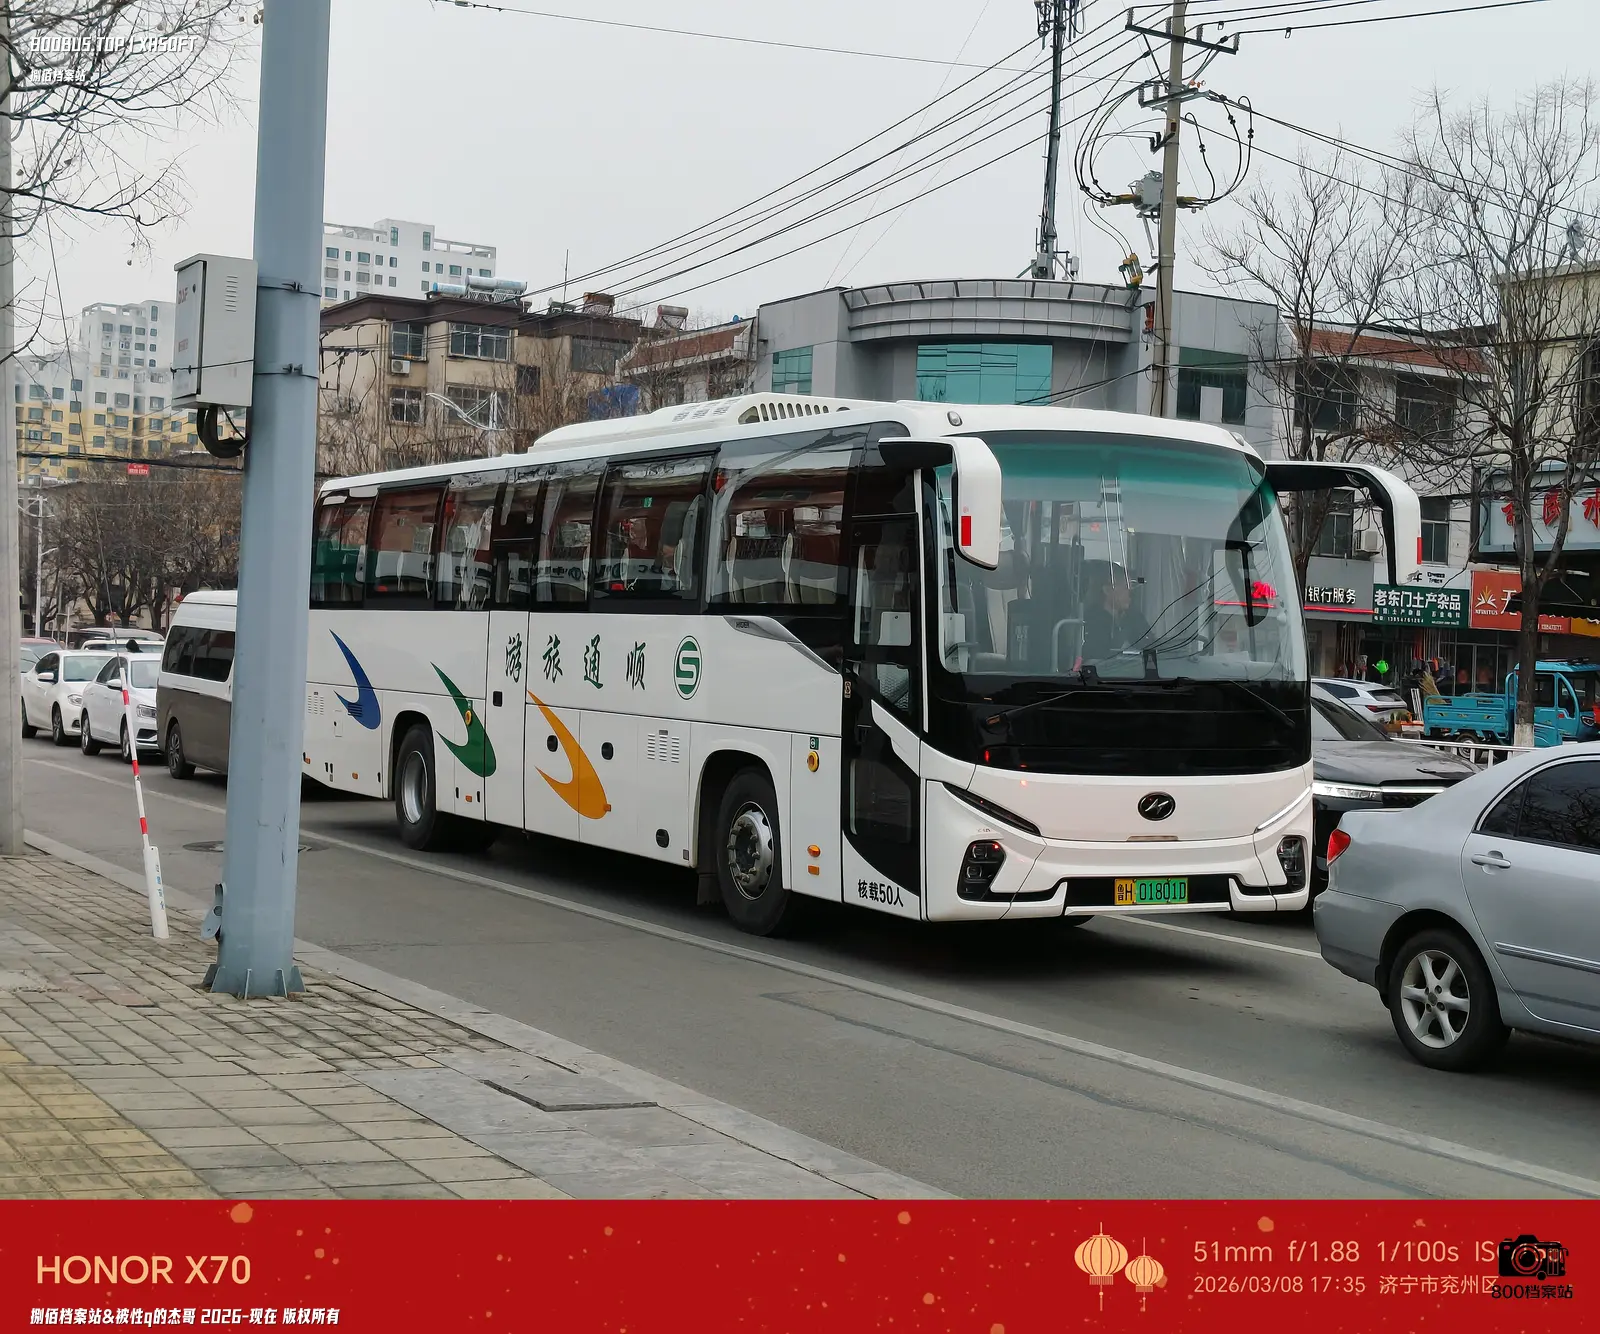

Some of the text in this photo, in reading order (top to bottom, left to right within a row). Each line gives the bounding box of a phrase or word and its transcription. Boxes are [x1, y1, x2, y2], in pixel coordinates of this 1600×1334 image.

[1374, 588, 1461, 611] 老东门土产杂品
[858, 878, 904, 907] 核载50人
